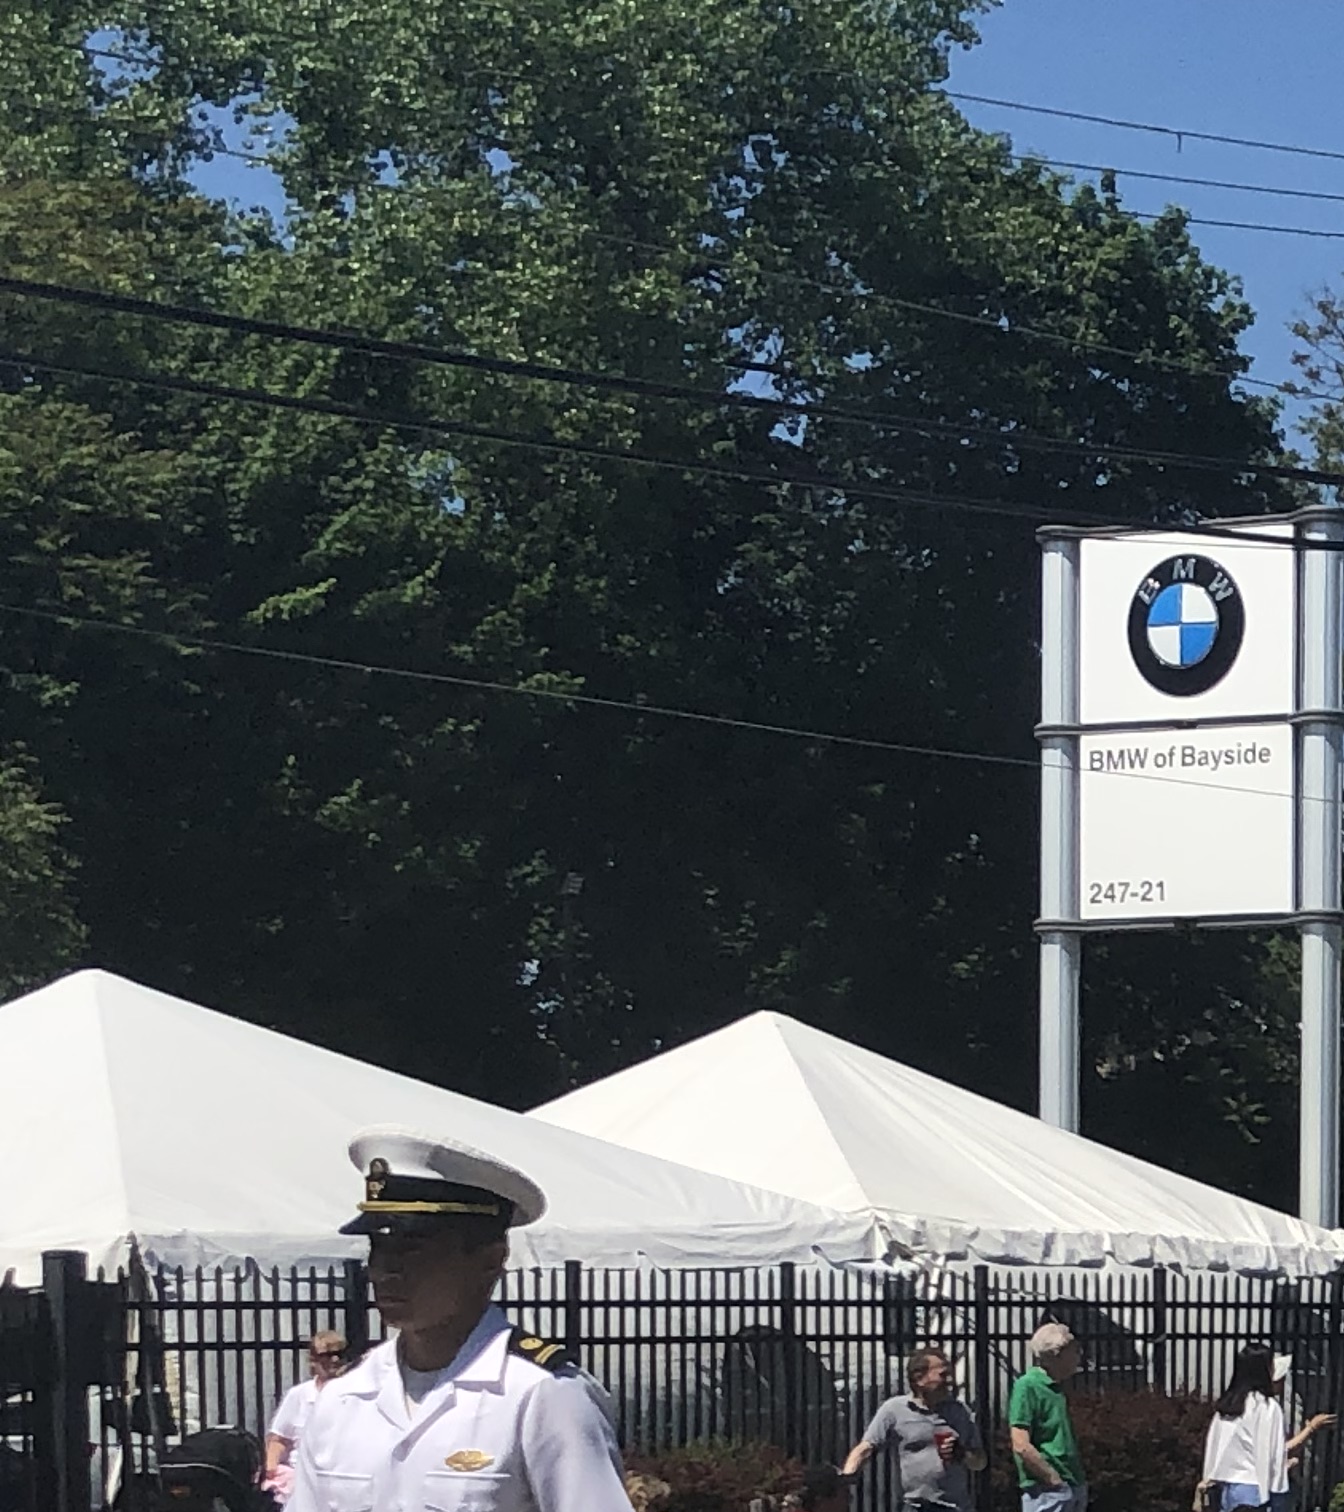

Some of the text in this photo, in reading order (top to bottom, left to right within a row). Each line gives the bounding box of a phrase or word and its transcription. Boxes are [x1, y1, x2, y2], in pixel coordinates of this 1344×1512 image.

[1138, 557, 1234, 605] BMW
[1089, 742, 1271, 771] BMW of Bayside
[1089, 880, 1165, 904] 247-21
